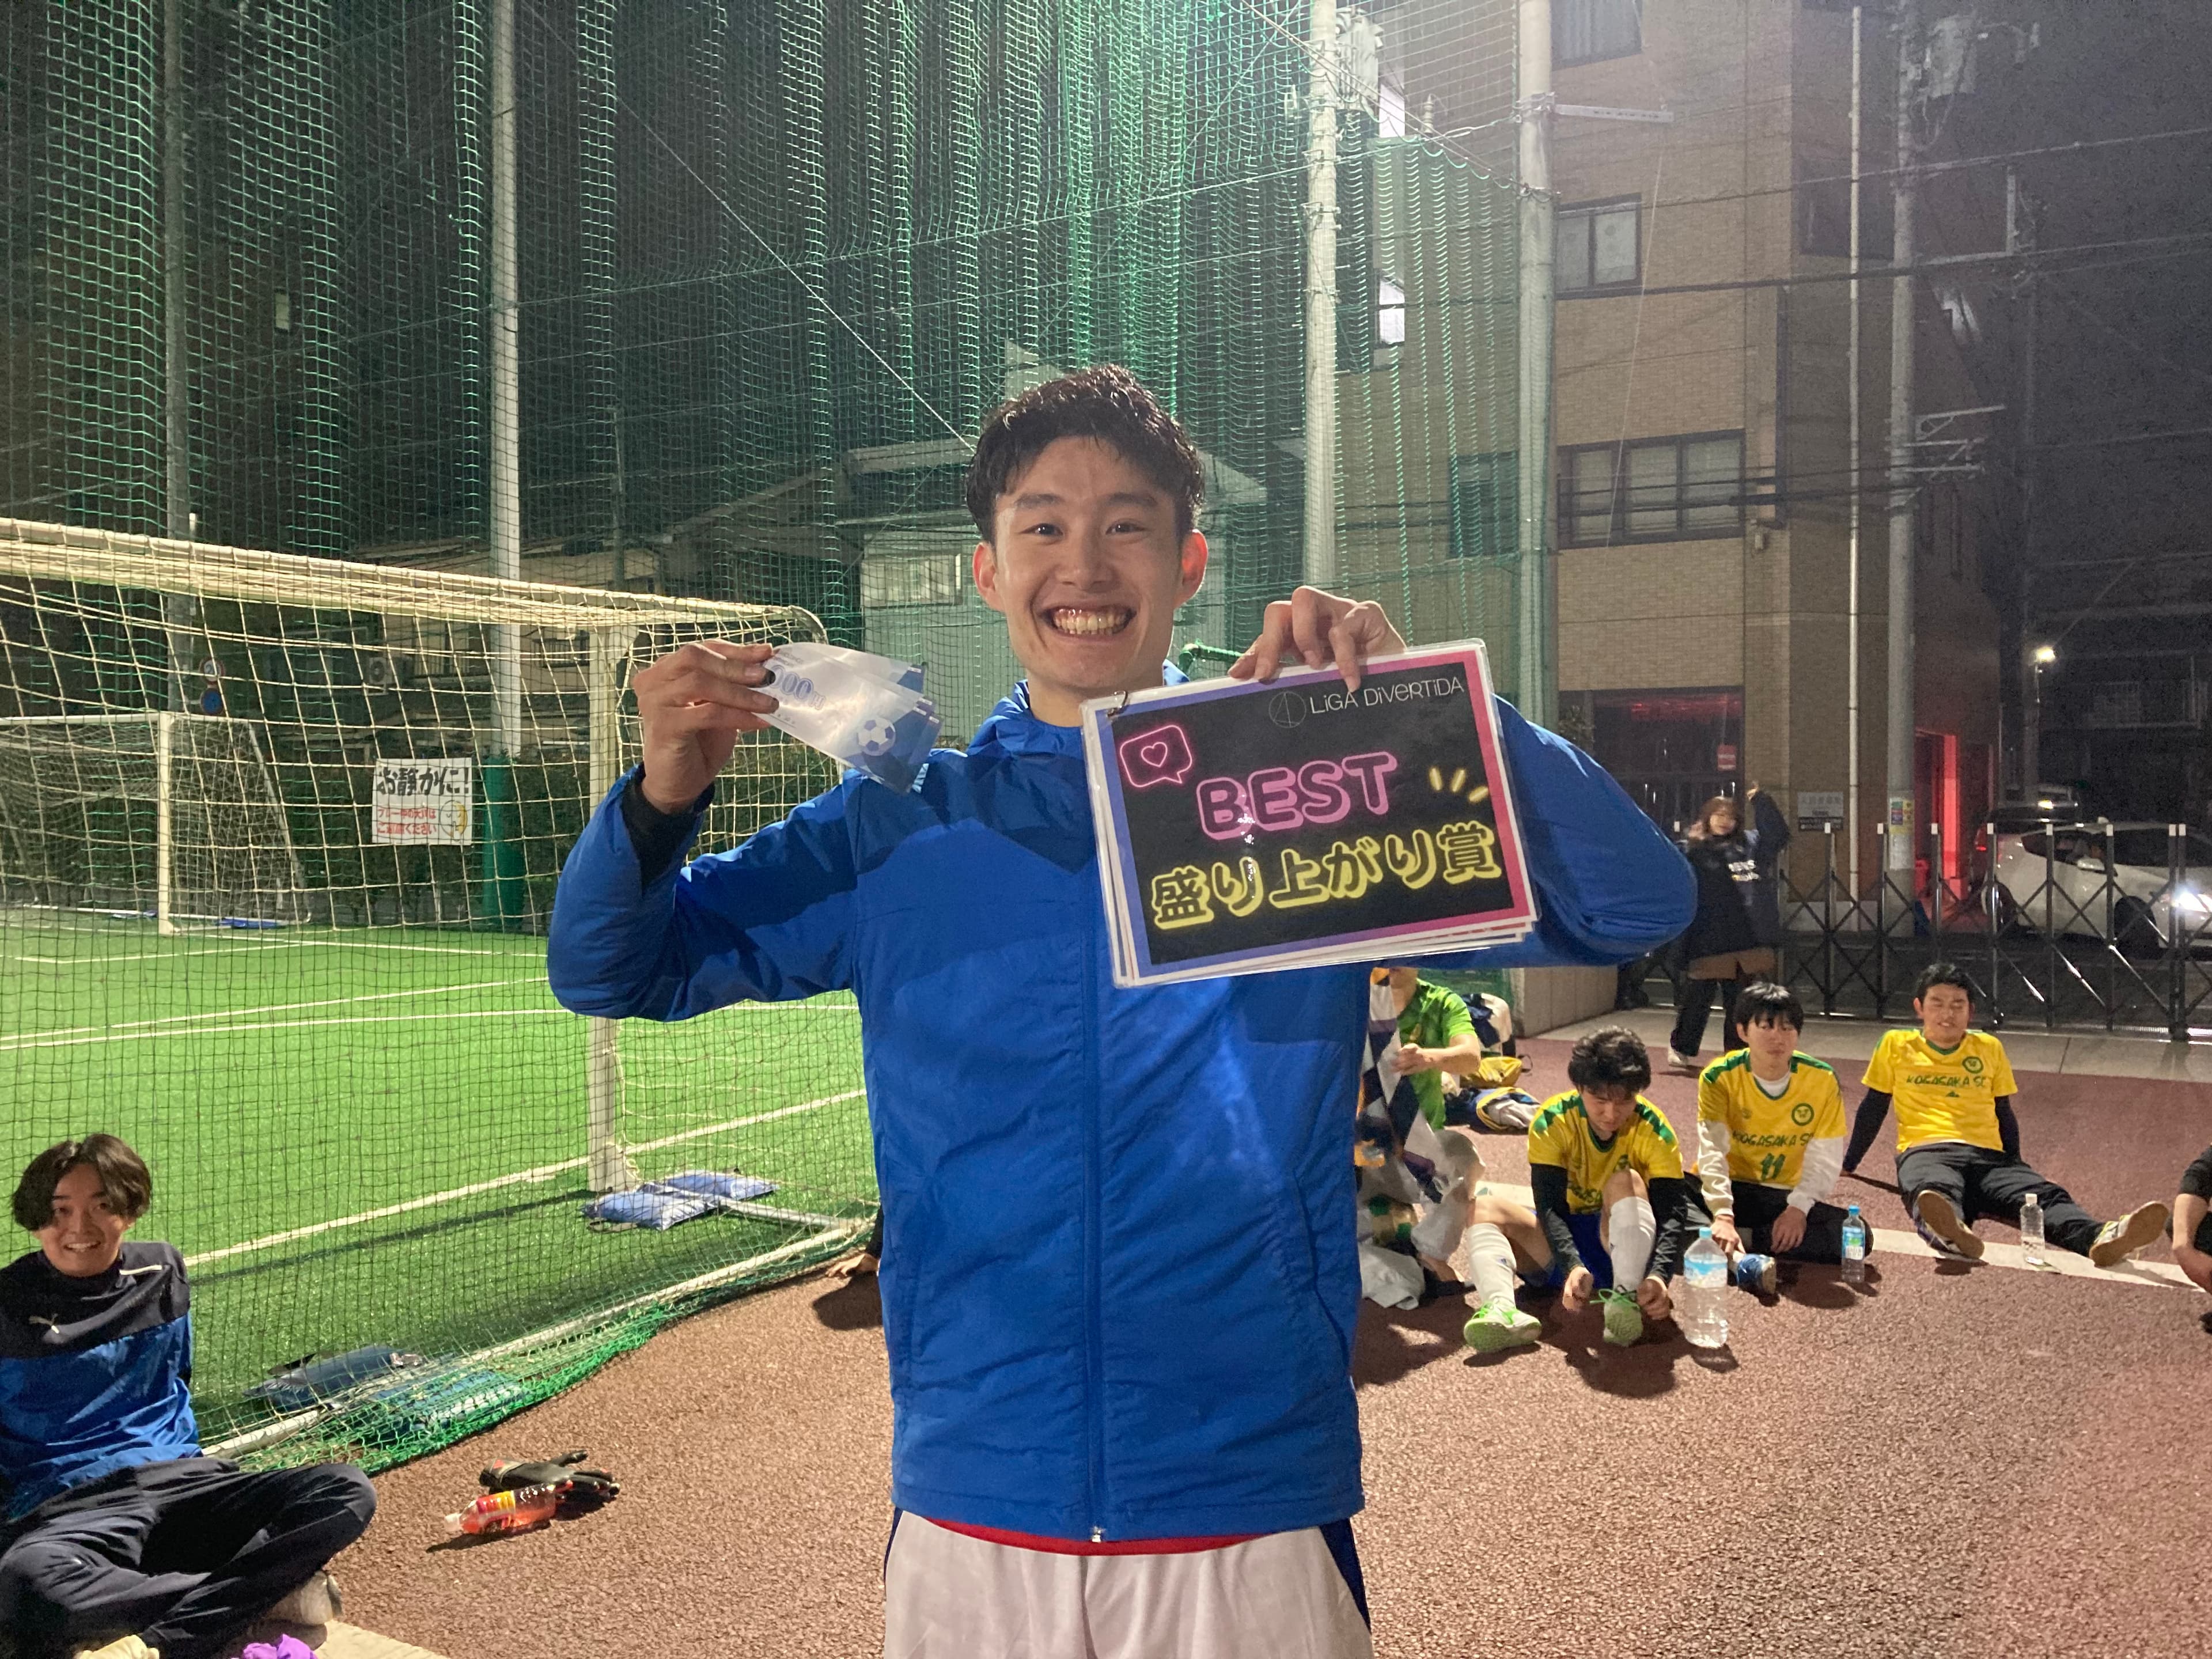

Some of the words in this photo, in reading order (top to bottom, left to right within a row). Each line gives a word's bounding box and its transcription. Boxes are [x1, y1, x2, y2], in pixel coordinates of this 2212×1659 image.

[1198, 752, 1397, 840] BEST
[1152, 821, 1501, 929] 盛り上がり賞
[1761, 1153, 1786, 1181] 11
